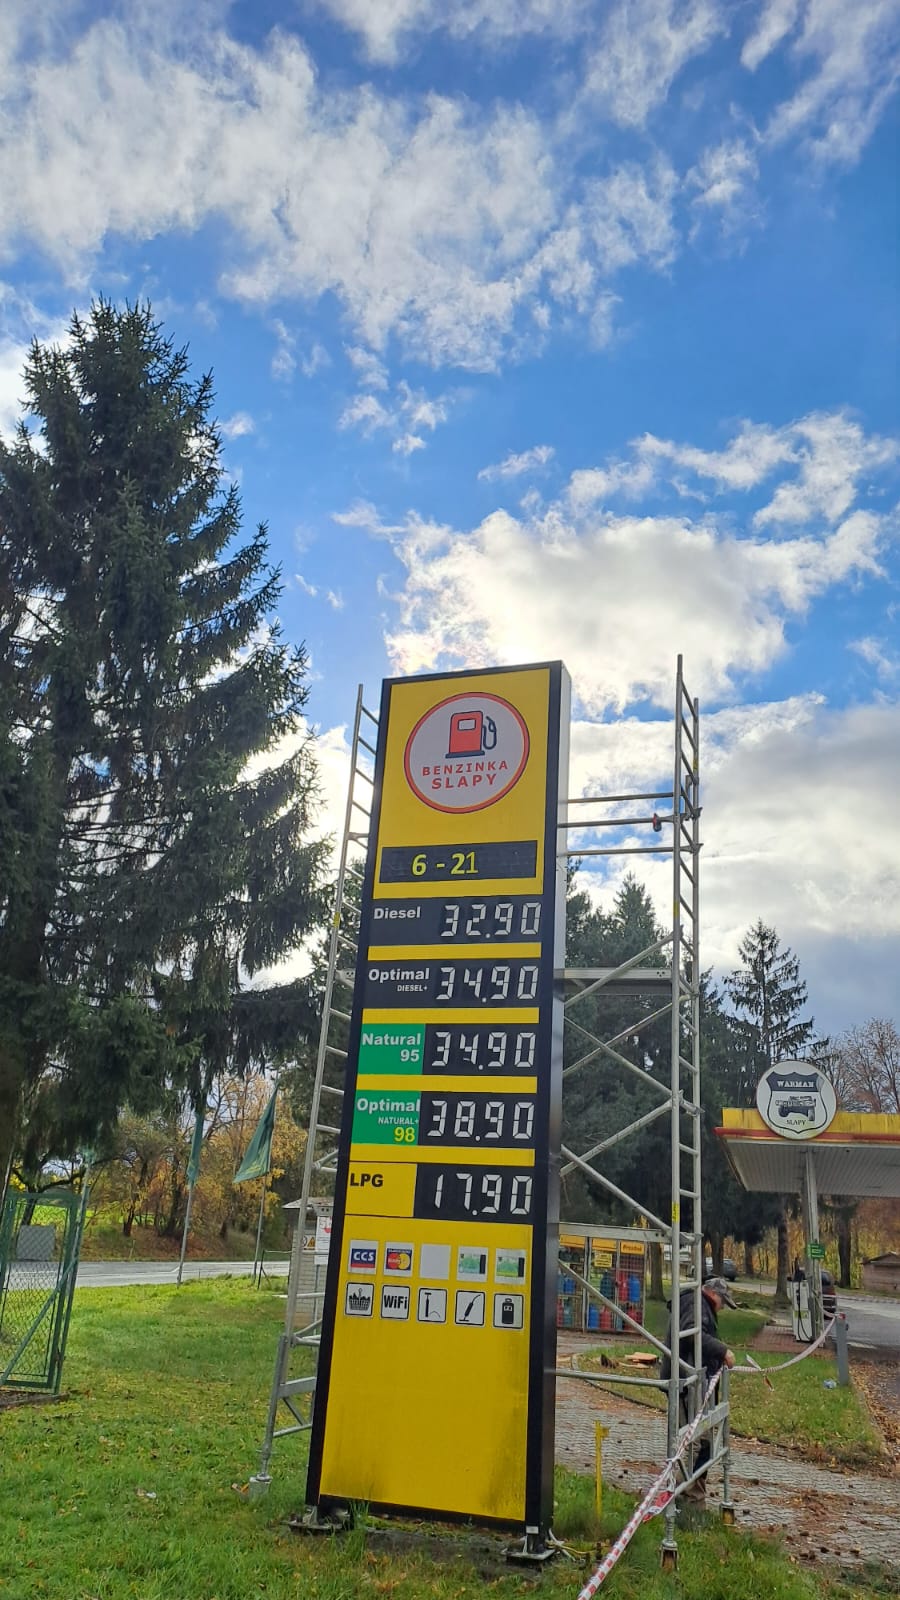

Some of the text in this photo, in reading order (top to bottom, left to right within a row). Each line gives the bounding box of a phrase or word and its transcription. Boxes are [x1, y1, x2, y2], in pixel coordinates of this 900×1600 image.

[422, 760, 508, 777] BENZINKA
[431, 773, 497, 790] SLAPY
[411, 853, 427, 876] 6
[450, 851, 479, 875] 21
[373, 906, 421, 920] Diesel
[440, 902, 542, 939] 32.90
[368, 967, 430, 983] Optimal
[396, 984, 428, 992] DIESEL+
[435, 965, 539, 1003] 34.90
[362, 1032, 421, 1046] Natural
[400, 1049, 420, 1063] 95
[431, 1031, 536, 1071] 34.90
[776, 1080, 815, 1088] WARMAN
[356, 1098, 420, 1115] Optimal
[427, 1100, 535, 1142] 38.90
[394, 1126, 415, 1143] 98
[349, 1172, 384, 1188] LPG
[434, 1172, 534, 1216] 17.90
[353, 1251, 375, 1262] CCS
[383, 1294, 408, 1310] WiFi
